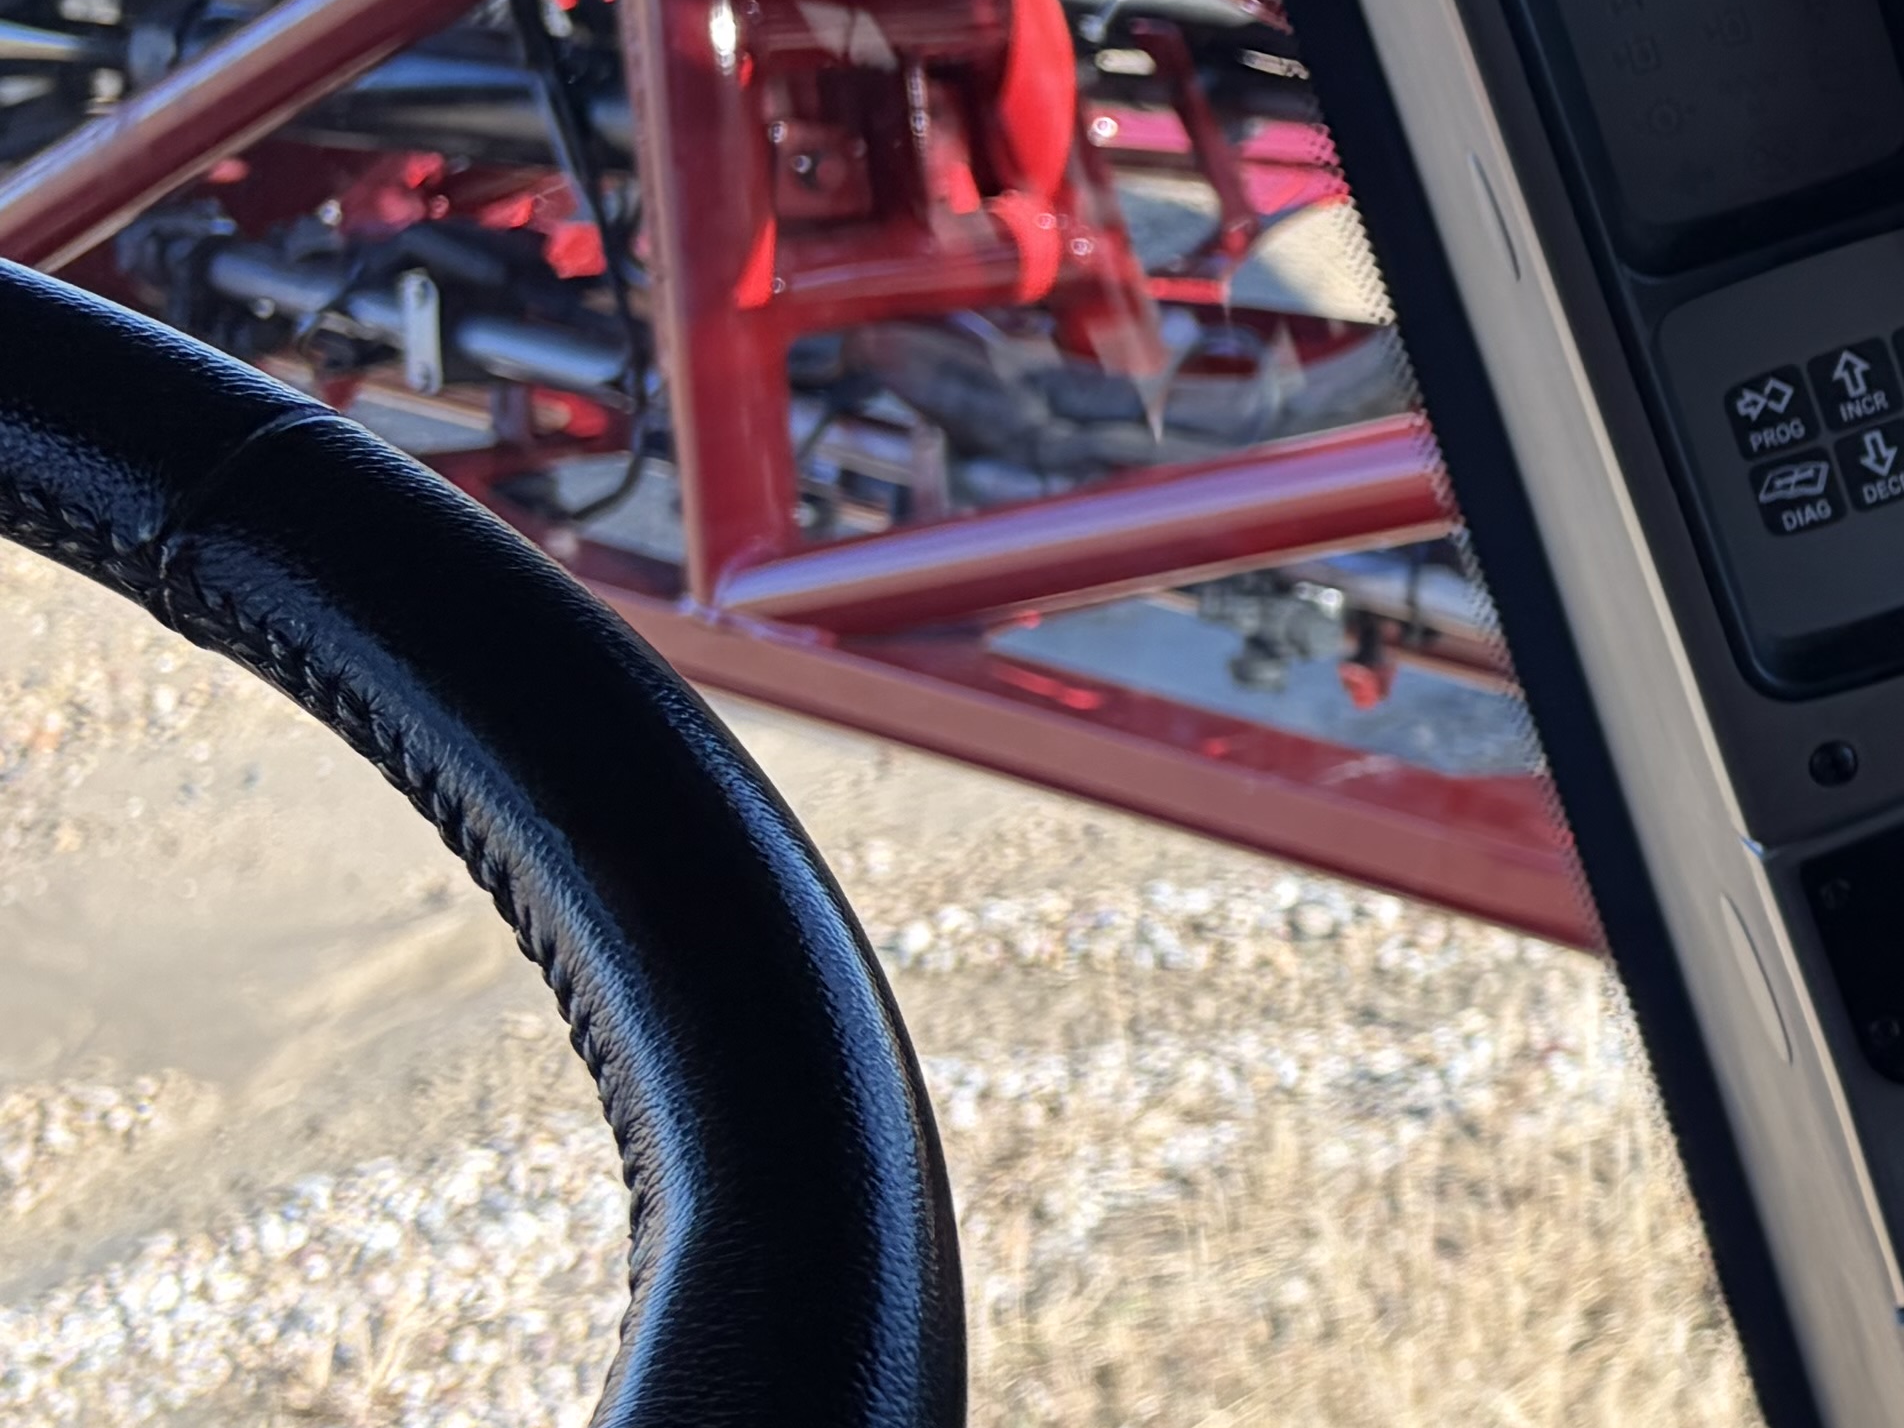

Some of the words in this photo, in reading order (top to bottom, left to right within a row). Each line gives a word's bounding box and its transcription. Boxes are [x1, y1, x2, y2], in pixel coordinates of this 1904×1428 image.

[1839, 390, 1889, 422] INCR
[1750, 419, 1805, 453] PROG
[1781, 499, 1832, 532] DIAG
